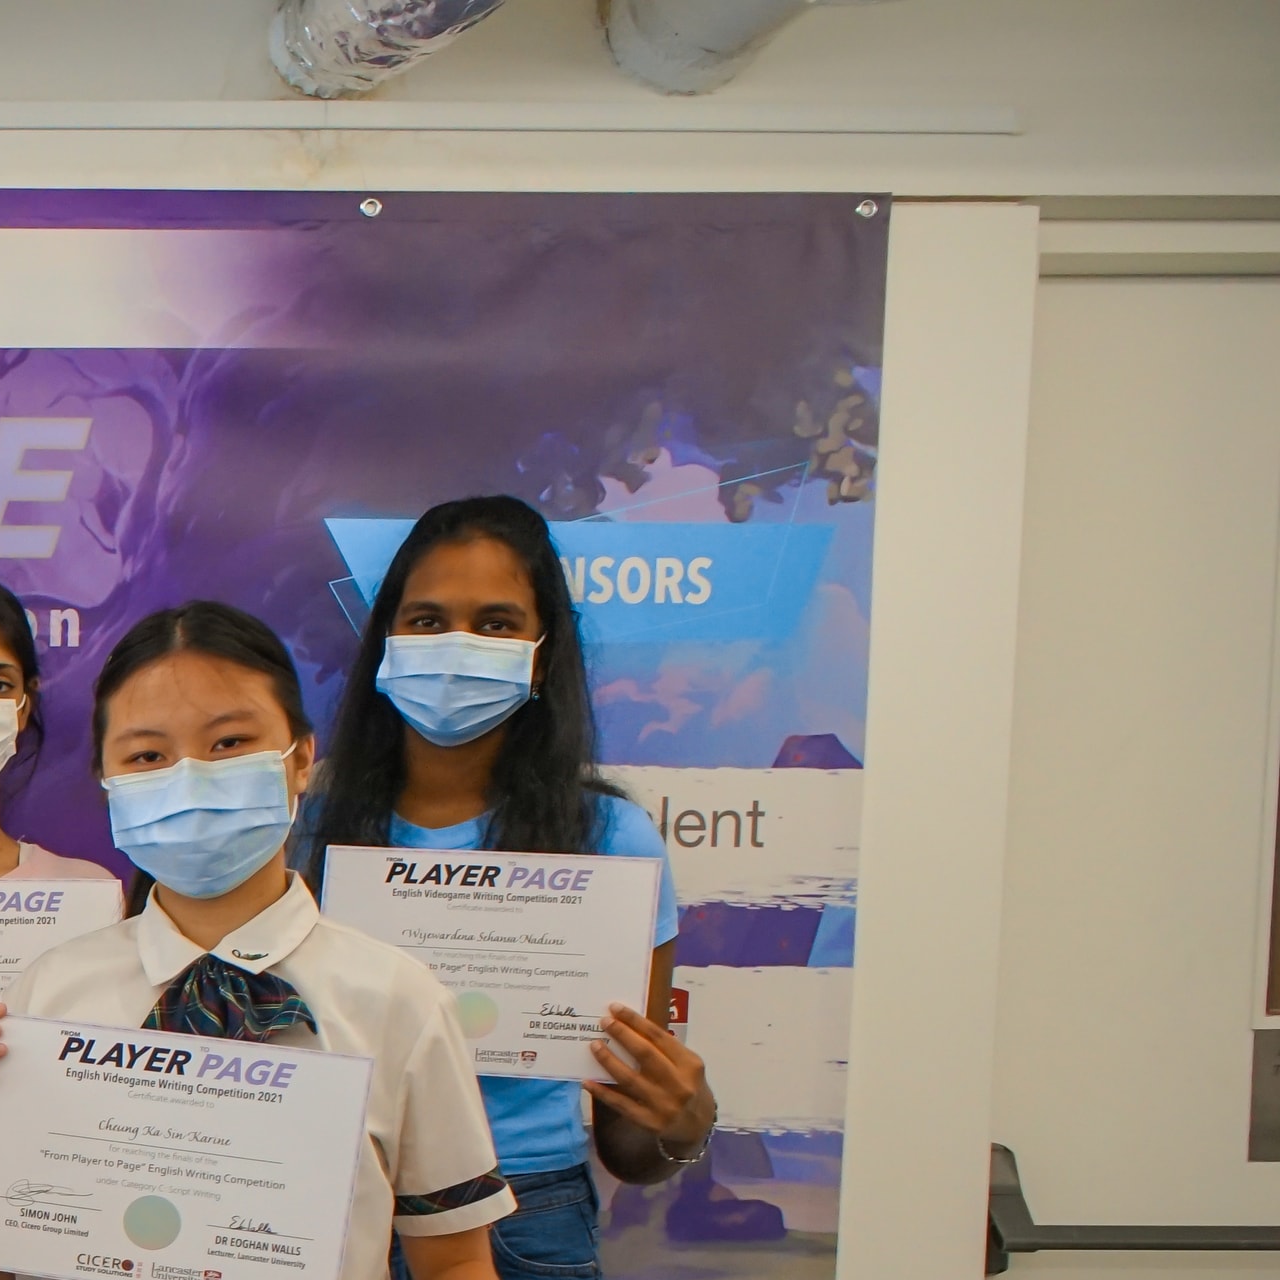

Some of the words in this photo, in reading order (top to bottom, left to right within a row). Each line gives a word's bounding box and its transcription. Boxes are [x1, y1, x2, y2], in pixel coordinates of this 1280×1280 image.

[560, 556, 713, 604] NSORS
[647, 797, 765, 848] lent
[385, 863, 501, 887] PLAYER
[506, 867, 593, 891] PAGE
[392, 888, 422, 899] English
[425, 890, 471, 901] Videogame
[473, 892, 504, 903] Writing
[506, 893, 558, 904] Competition
[560, 895, 582, 904] 2021
[58, 1037, 192, 1076] PLAYER
[196, 1054, 298, 1089] PAGE
[66, 1068, 100, 1081] English
[103, 1072, 155, 1087] Videogame
[159, 1079, 193, 1095] Writing
[196, 1084, 255, 1100] Competition
[258, 1092, 282, 1103] 2021
[215, 1236, 228, 1245] DR
[230, 1238, 269, 1251] EOGHAN
[272, 1244, 301, 1256] WALLS
[76, 1253, 134, 1272] CICERO
